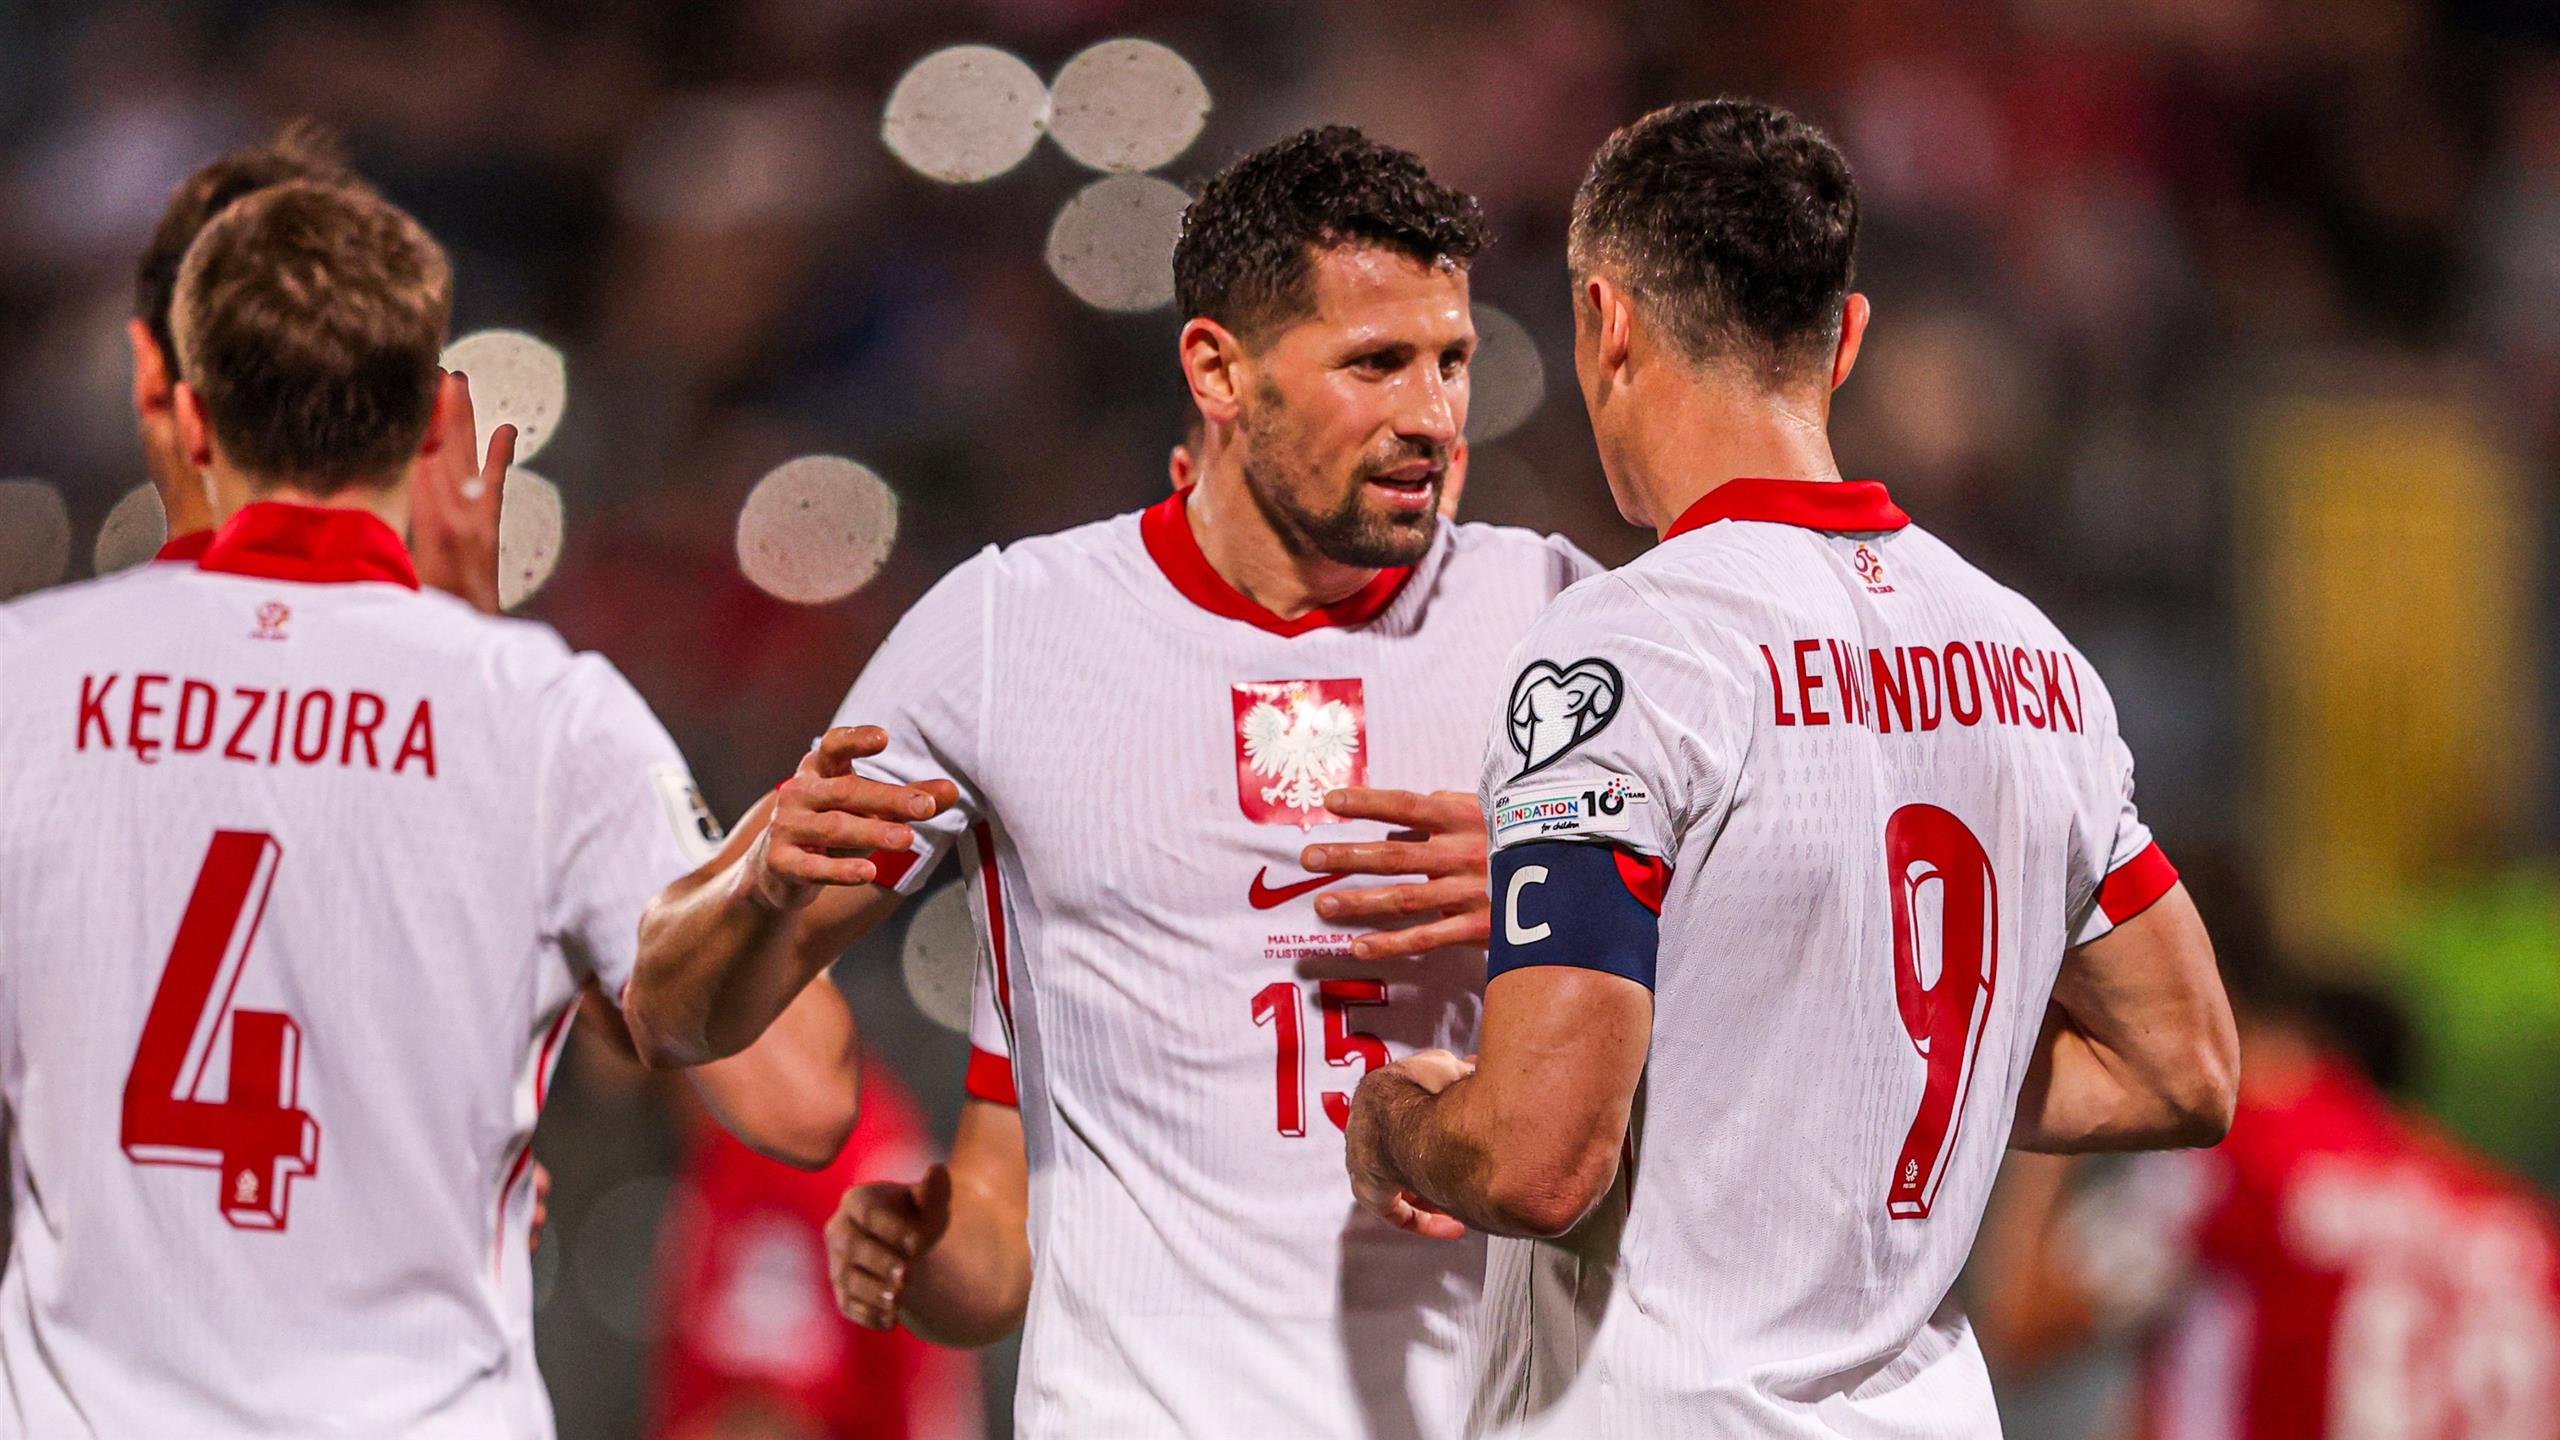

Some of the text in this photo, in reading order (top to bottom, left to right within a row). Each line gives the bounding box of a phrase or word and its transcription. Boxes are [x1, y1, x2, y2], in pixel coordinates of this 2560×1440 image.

[76, 673, 437, 779] KĘDZIORA
[1759, 638, 2083, 735] LEWNDOWSKI
[1496, 801, 1578, 828] FOUNDATION
[1541, 821, 1580, 834] for children
[1581, 790, 1625, 817] 10
[1505, 865, 1551, 945] C
[1264, 949, 1275, 959] 17
[1276, 948, 1333, 959] LISTOPADA
[120, 829, 320, 1232] 4
[1885, 803, 1998, 1219] 9
[1251, 979, 1392, 1138] 15
